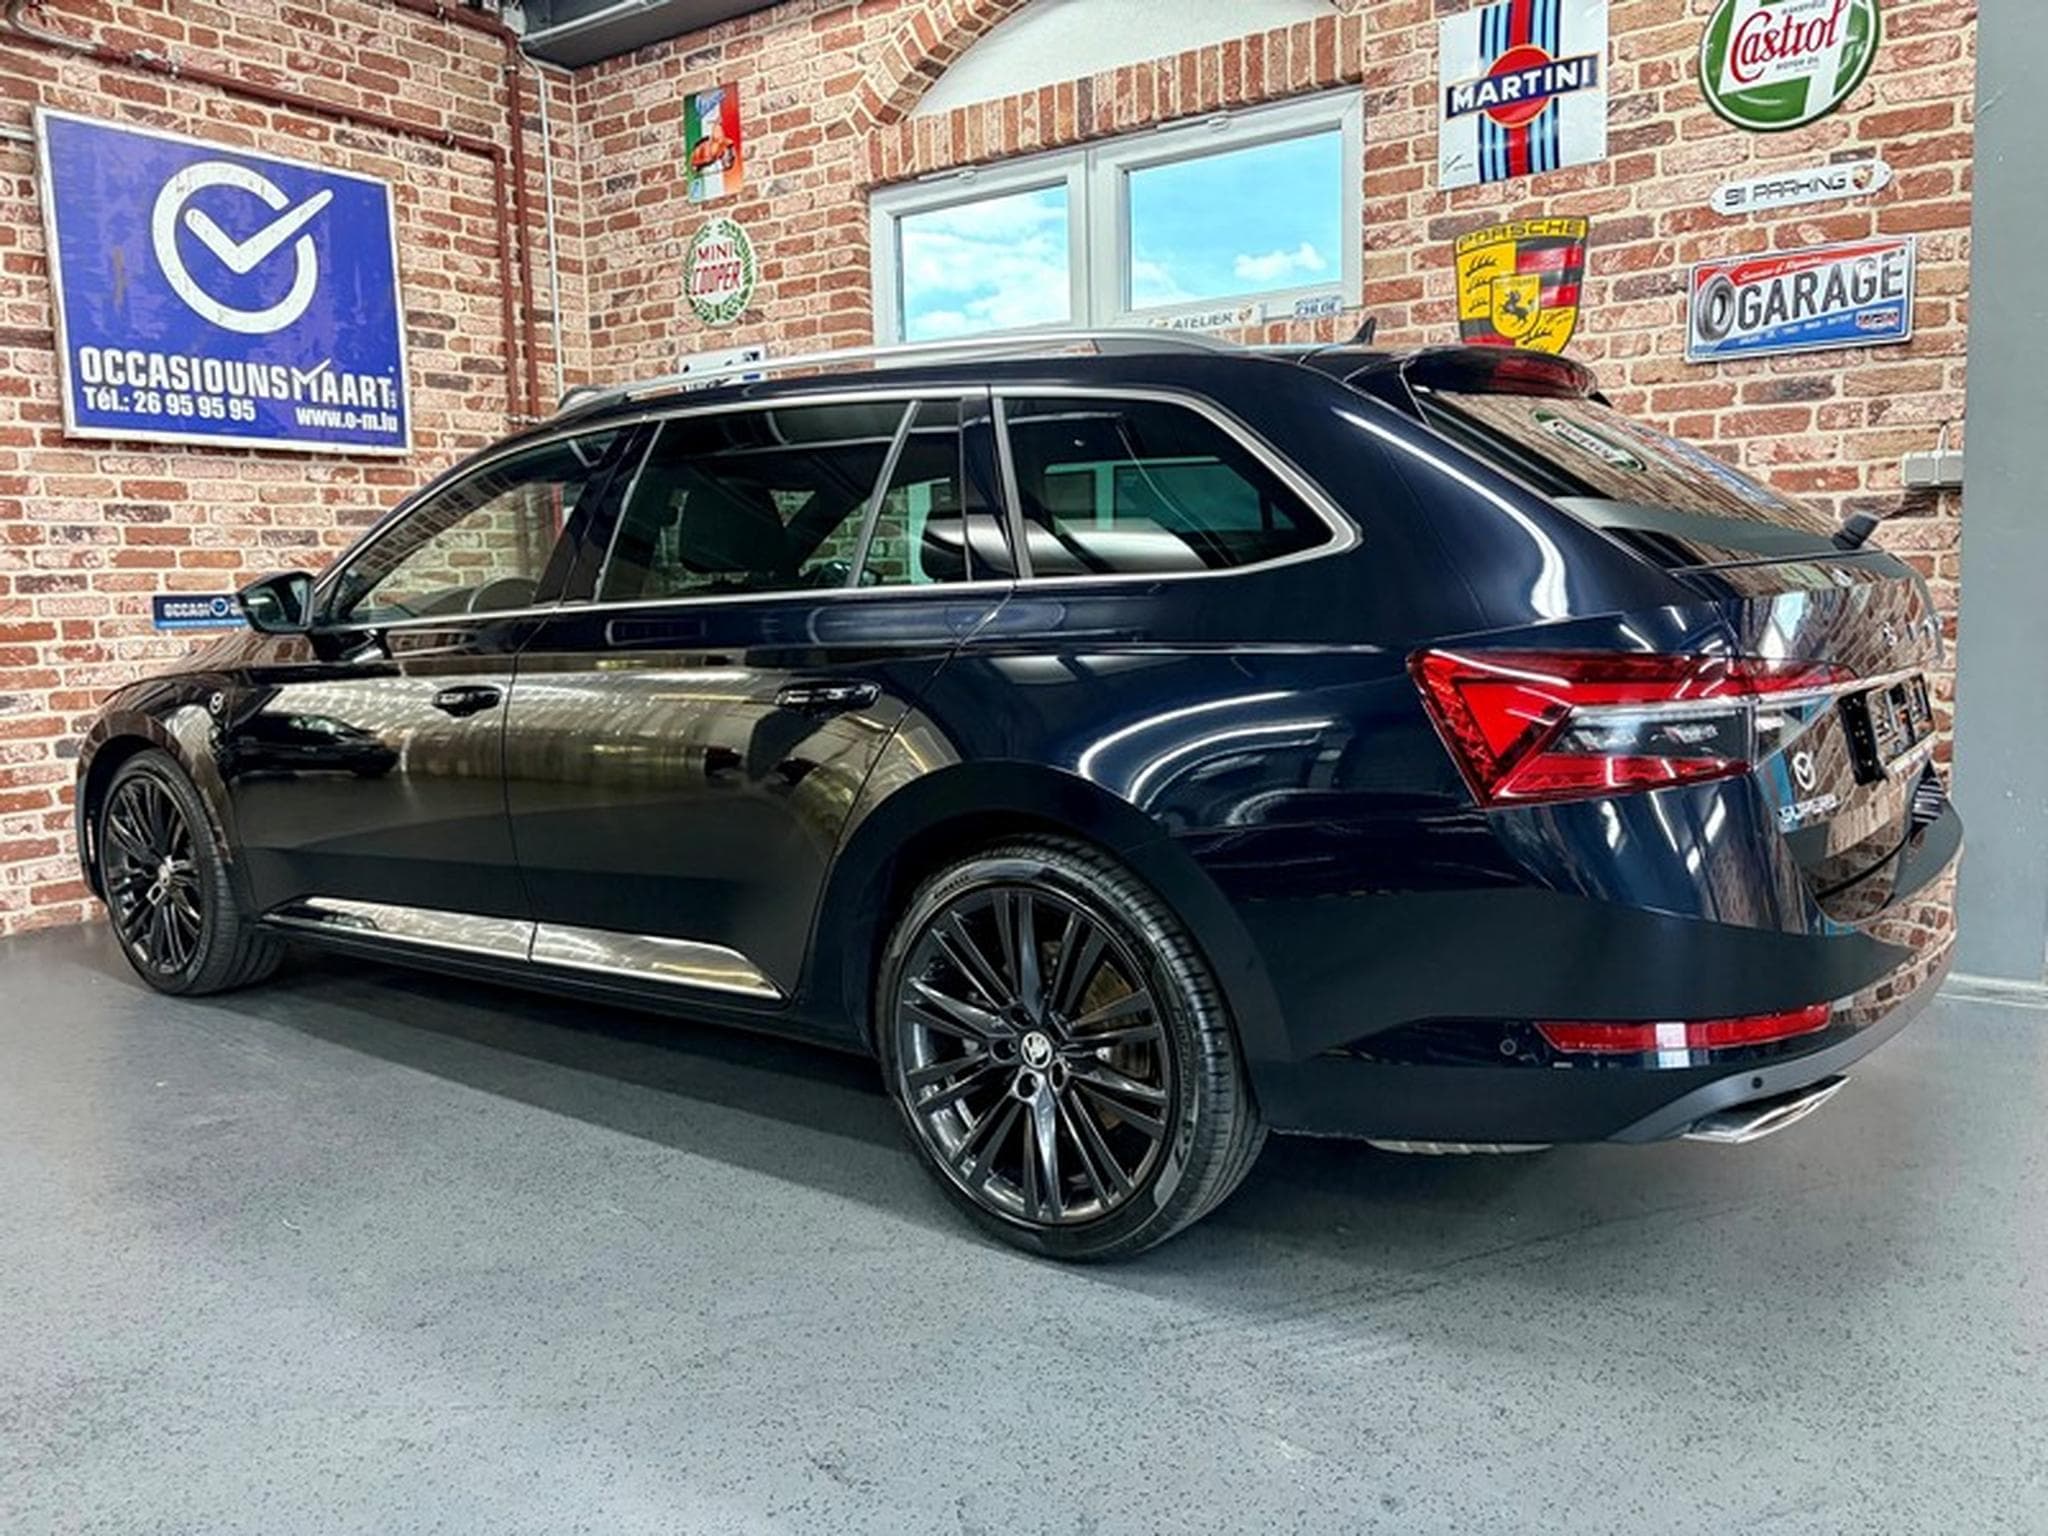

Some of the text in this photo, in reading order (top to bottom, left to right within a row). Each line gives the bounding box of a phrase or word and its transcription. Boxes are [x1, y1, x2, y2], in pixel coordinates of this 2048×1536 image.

[1730, 0, 1848, 85] Castrol
[1452, 58, 1591, 113] MARTINI
[1753, 171, 1847, 201] PARKING
[698, 241, 734, 261] MINI
[1458, 220, 1583, 251] PORSCHE
[692, 260, 741, 296] COOPER
[1736, 250, 1905, 331] GARAGE
[1172, 312, 1233, 330] ATELIER
[82, 386, 257, 421] Tél.: 26 95 95 95
[296, 406, 398, 433] www.o-m.lu
